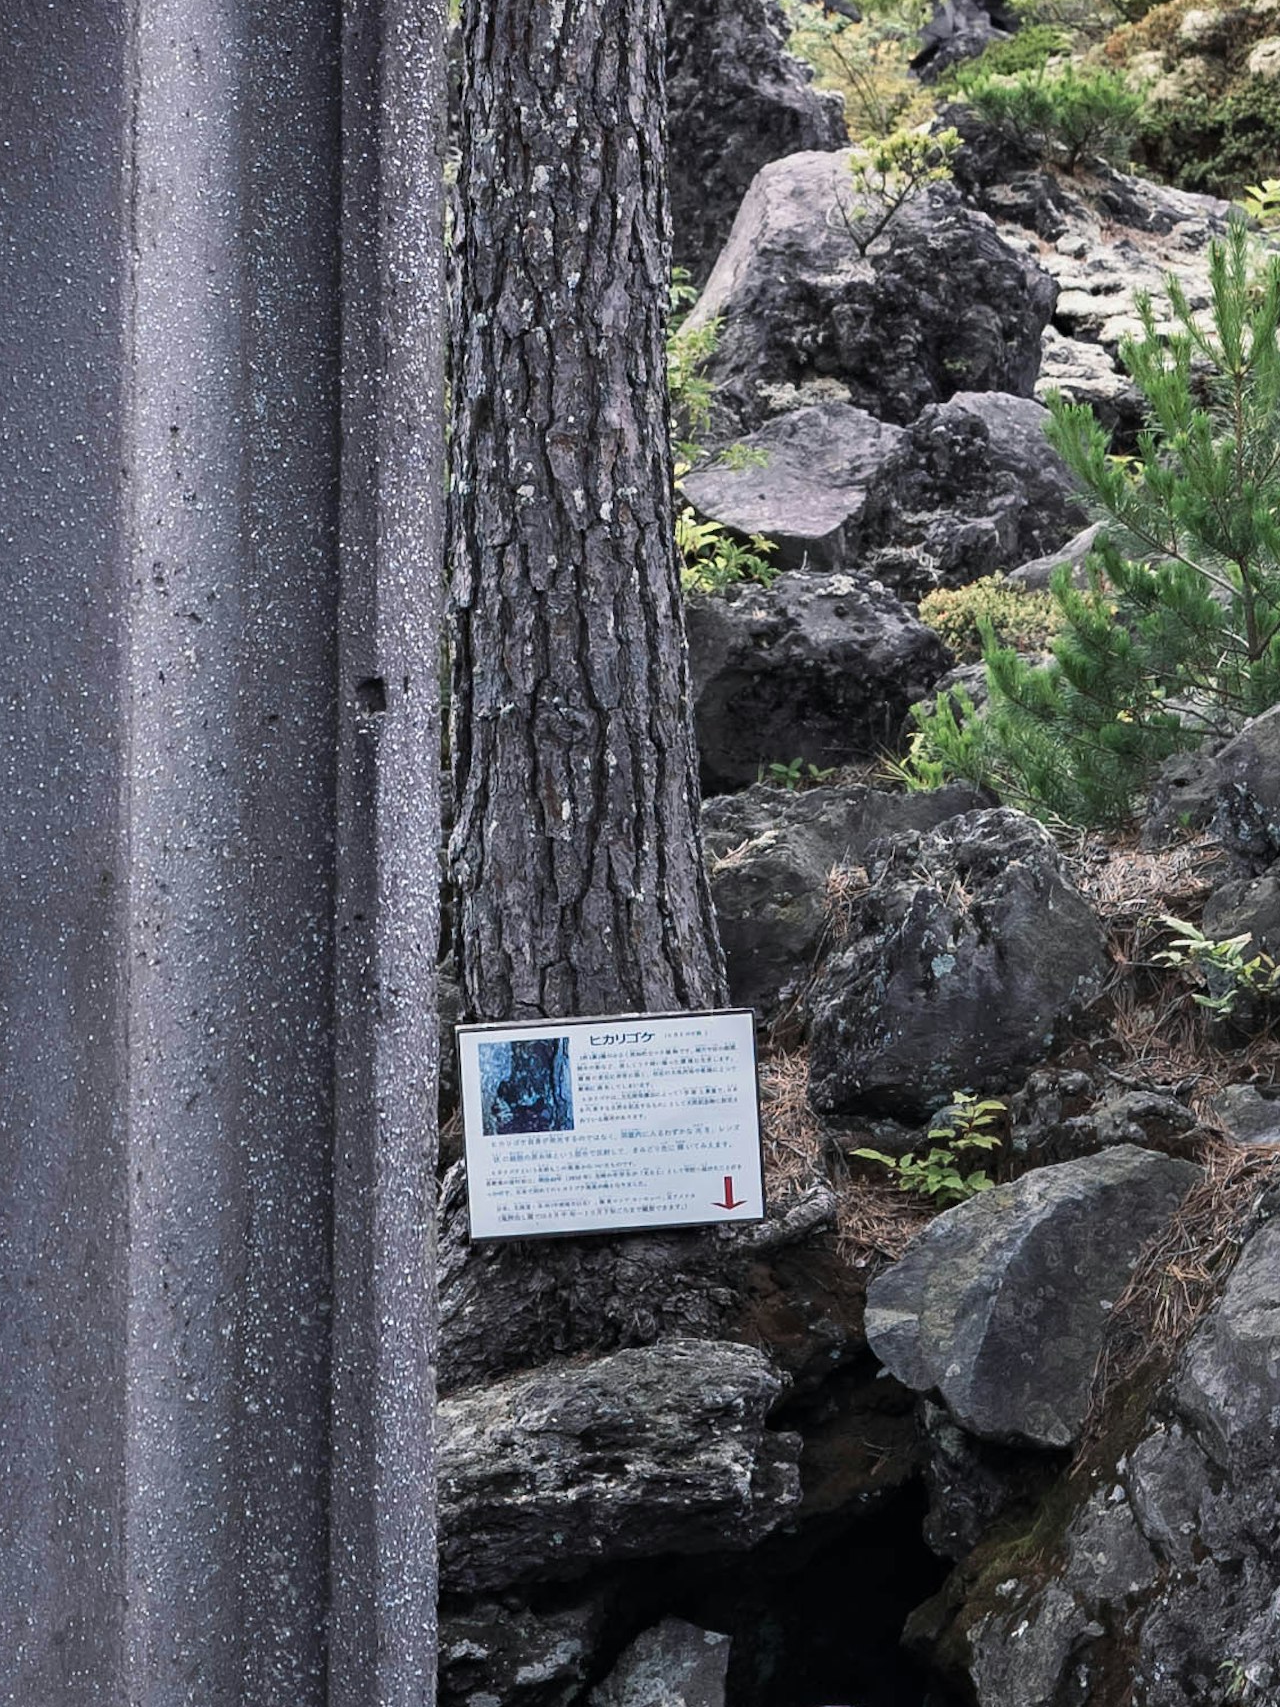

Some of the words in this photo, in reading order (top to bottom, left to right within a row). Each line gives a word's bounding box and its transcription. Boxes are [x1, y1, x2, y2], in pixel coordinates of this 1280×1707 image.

[589, 1030, 656, 1047] ヒカリゴケ
